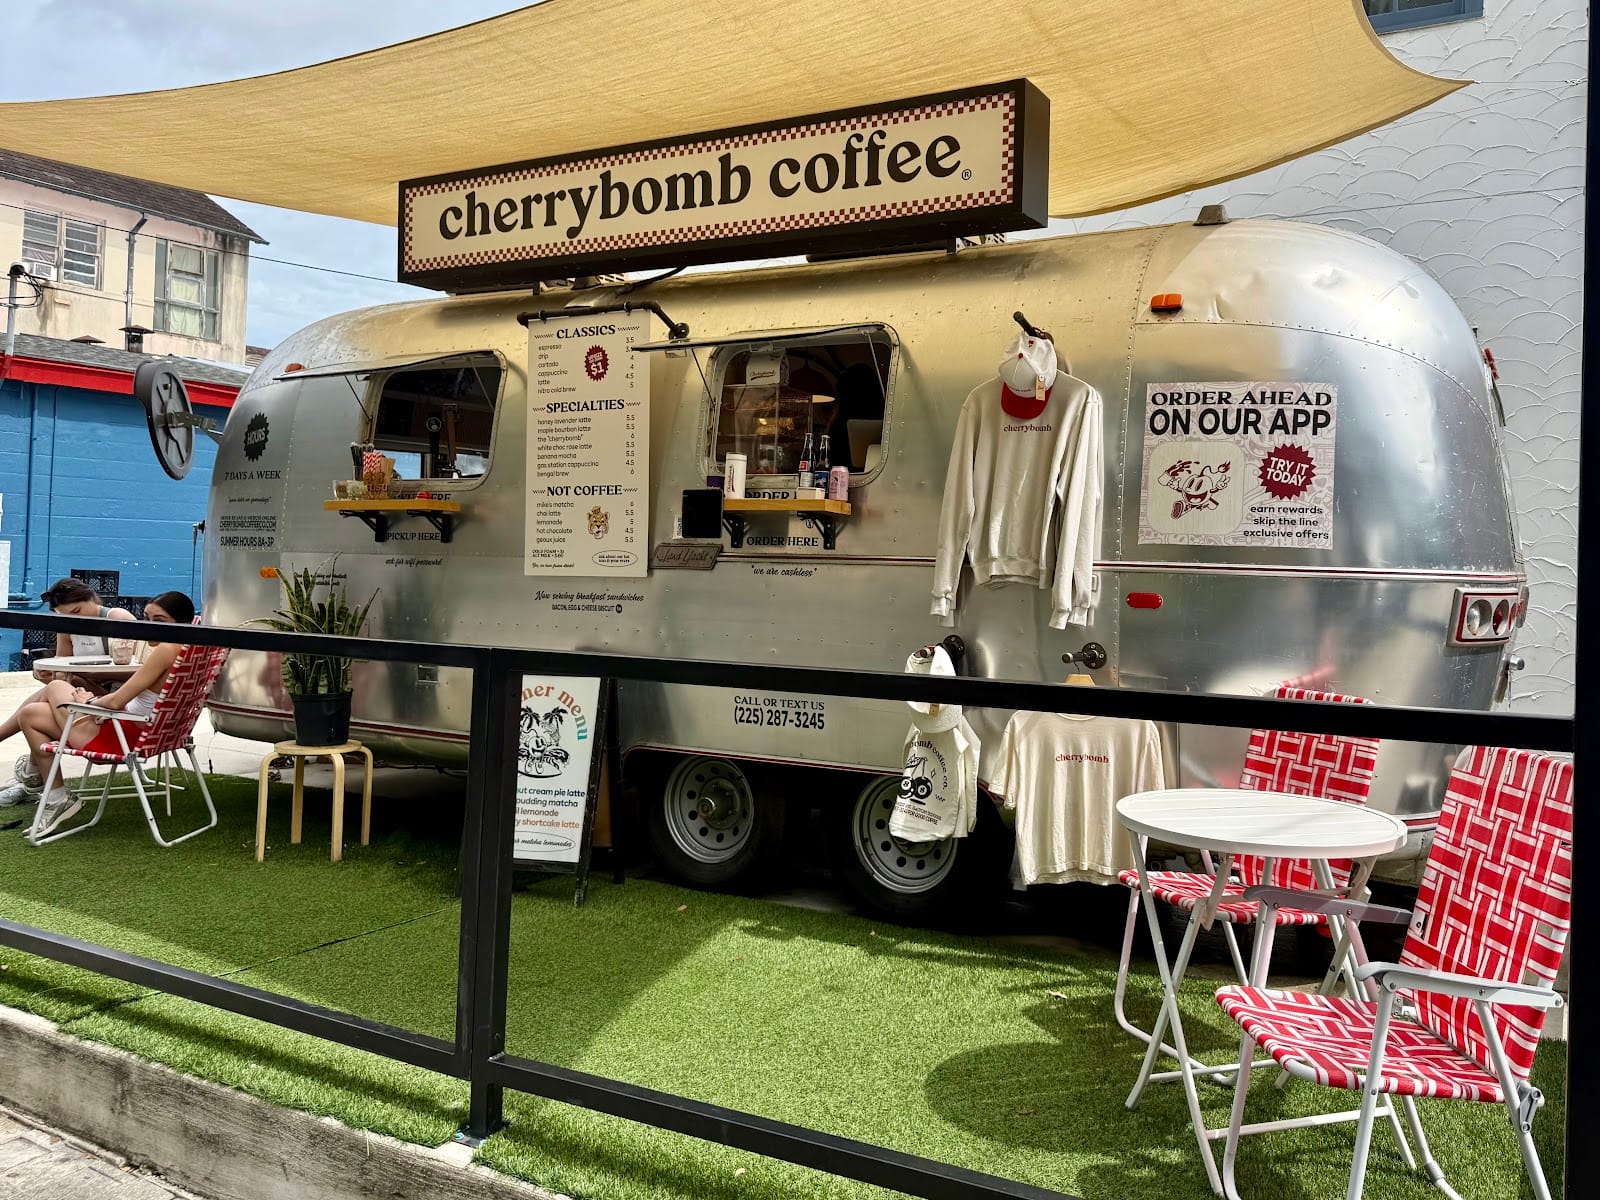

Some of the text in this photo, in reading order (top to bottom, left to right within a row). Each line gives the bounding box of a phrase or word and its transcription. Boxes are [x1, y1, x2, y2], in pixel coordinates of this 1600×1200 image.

[439, 130, 962, 239] cherrybomb coffee
[556, 324, 616, 339] CLASSICS
[538, 369, 568, 377] cappuccino
[590, 362, 605, 376] $1
[1151, 391, 1331, 406] ORDER AHEAD
[546, 399, 624, 413] SPECIALTIES
[1150, 408, 1331, 436] ON OUR APP
[1004, 424, 1052, 433] cherrybomb
[247, 428, 266, 446] HOURS
[547, 434, 583, 443] "cherrybomb"
[1270, 457, 1309, 474] TRY IT
[225, 470, 281, 480] 7 DAYS A WEEK
[1267, 468, 1306, 486] TODAY
[547, 485, 623, 496] NOT COFFEE
[1250, 506, 1323, 515] earn rewards
[1254, 517, 1318, 526] skip the line
[387, 532, 440, 541] PICKUP HERE
[1243, 529, 1329, 539] exclusive offers
[220, 537, 275, 547] SUMMER HOURS 8A-3P
[747, 536, 819, 547] ORDER HERE
[395, 558, 404, 567] for
[405, 558, 415, 567] wifi
[416, 558, 443, 567] password
[752, 565, 817, 577] "we are cashless"
[534, 590, 644, 603] Now serving breakfast sandwiches
[734, 696, 825, 710] CALL OR TEXT US
[558, 691, 588, 741] menu
[734, 705, 825, 730] (225) 287-3245
[932, 747, 947, 773] coffee
[1055, 753, 1109, 764] cherrybomb
[529, 788, 553, 796] cream
[554, 788, 566, 798] pie
[567, 789, 586, 797] latte
[520, 808, 559, 817] lemonade
[522, 818, 560, 828] shortcake
[562, 820, 580, 828] latte
[543, 839, 572, 847] lemonades
